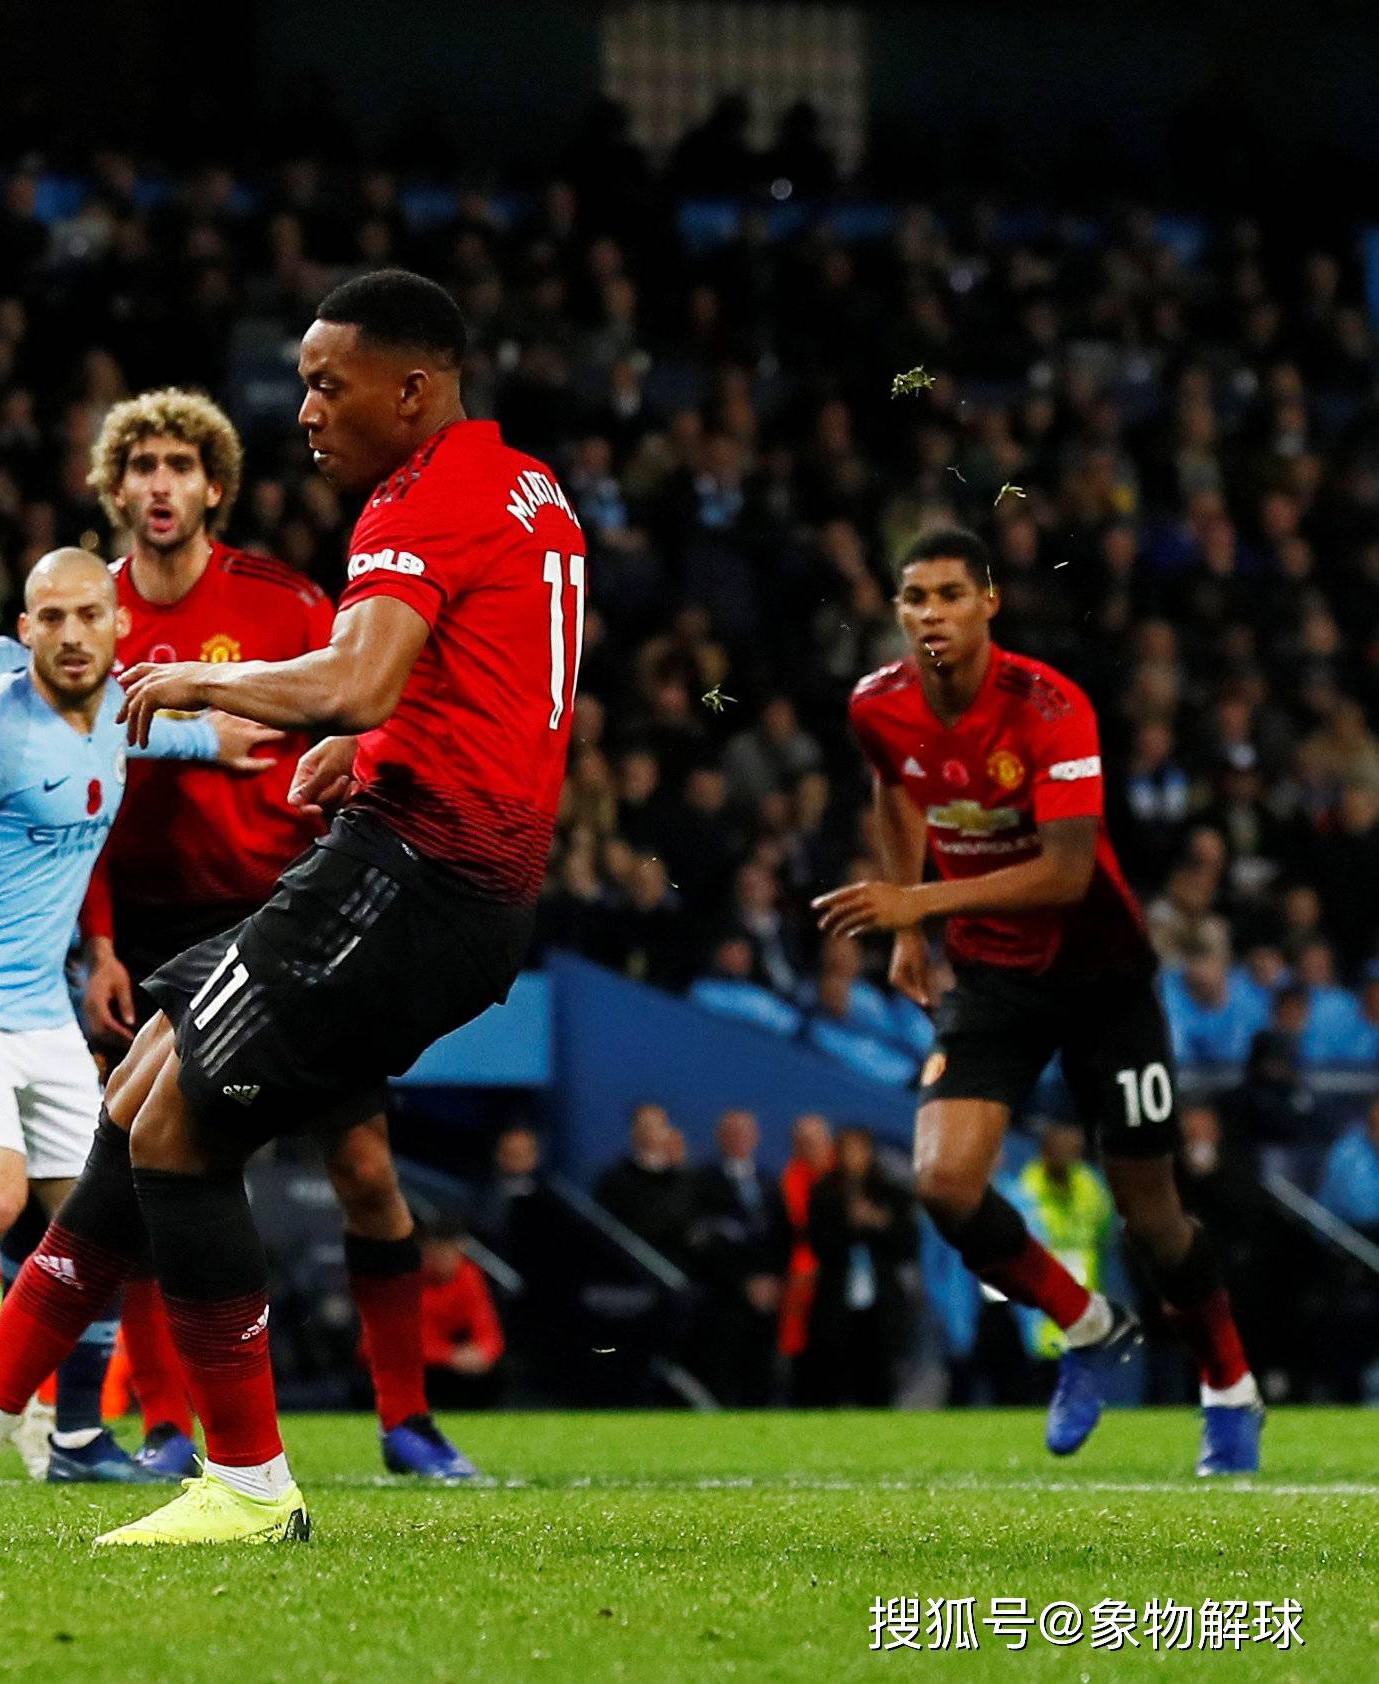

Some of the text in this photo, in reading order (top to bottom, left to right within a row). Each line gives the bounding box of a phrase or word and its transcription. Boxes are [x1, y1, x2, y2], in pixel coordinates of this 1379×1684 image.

[543, 550, 585, 730] 11
[27, 814, 111, 846] ETIHA
[188, 942, 250, 1032] 11
[1116, 1061, 1173, 1128] 10
